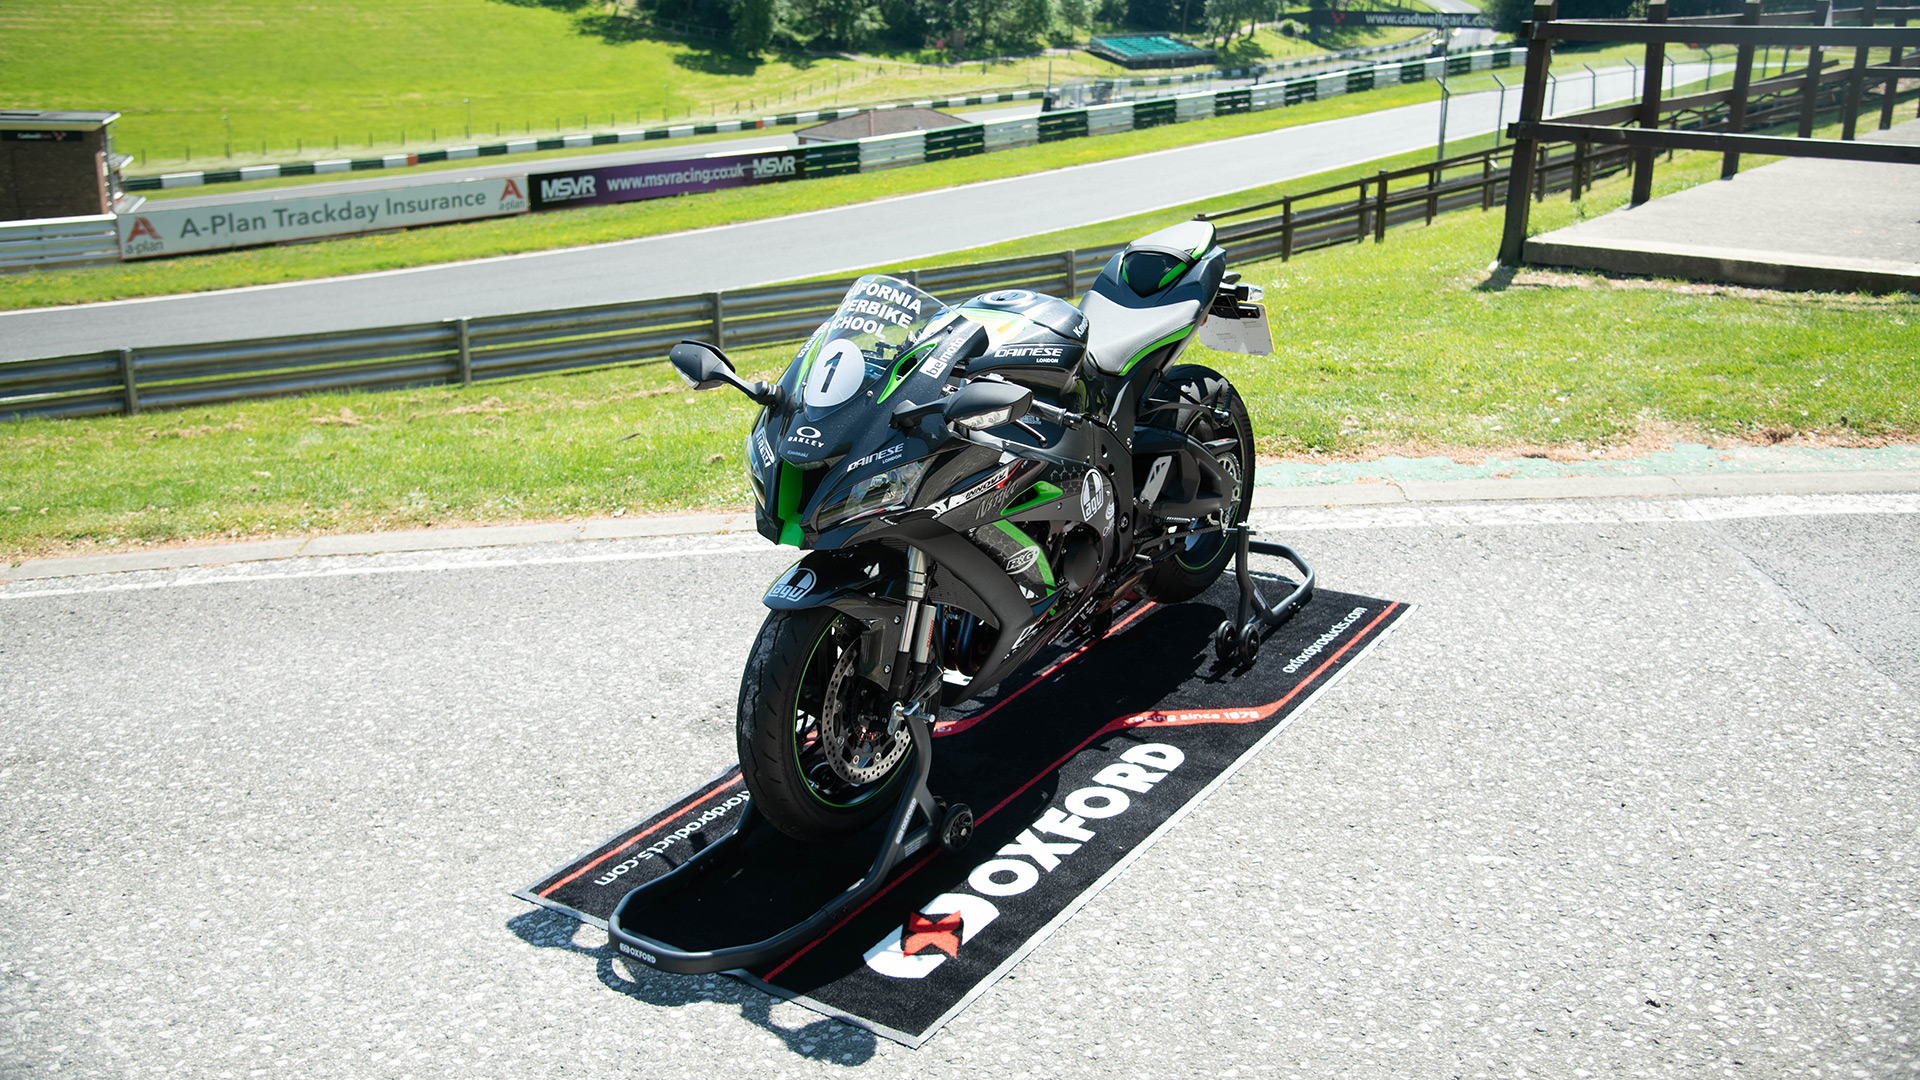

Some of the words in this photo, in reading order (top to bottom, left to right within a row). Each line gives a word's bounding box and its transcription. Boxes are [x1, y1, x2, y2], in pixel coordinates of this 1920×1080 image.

[606, 162, 744, 192] www.msvracing.co.uk
[753, 155, 796, 177] MSVR
[541, 175, 596, 201] MSVR
[180, 212, 267, 239] A-Plan
[273, 196, 379, 231] Trackday
[386, 190, 487, 216] Insurance
[853, 282, 921, 315] IFORNIA
[830, 315, 887, 340] CHOOL
[840, 299, 914, 330] PERBIKE
[994, 347, 1063, 358] DAINESE
[820, 351, 843, 393] 1
[787, 436, 825, 449] OAKLEY
[846, 442, 905, 473] DAINESE
[882, 453, 903, 465] LONDON
[1007, 551, 1034, 571] R&G
[772, 583, 803, 600] agv
[1282, 606, 1368, 674] oxfordproducts.com
[1128, 715, 1177, 723] racing
[1180, 713, 1221, 721] since
[900, 797, 917, 831] OXFORD
[967, 742, 1186, 897] OXFORD
[629, 948, 656, 964] OXFORD
